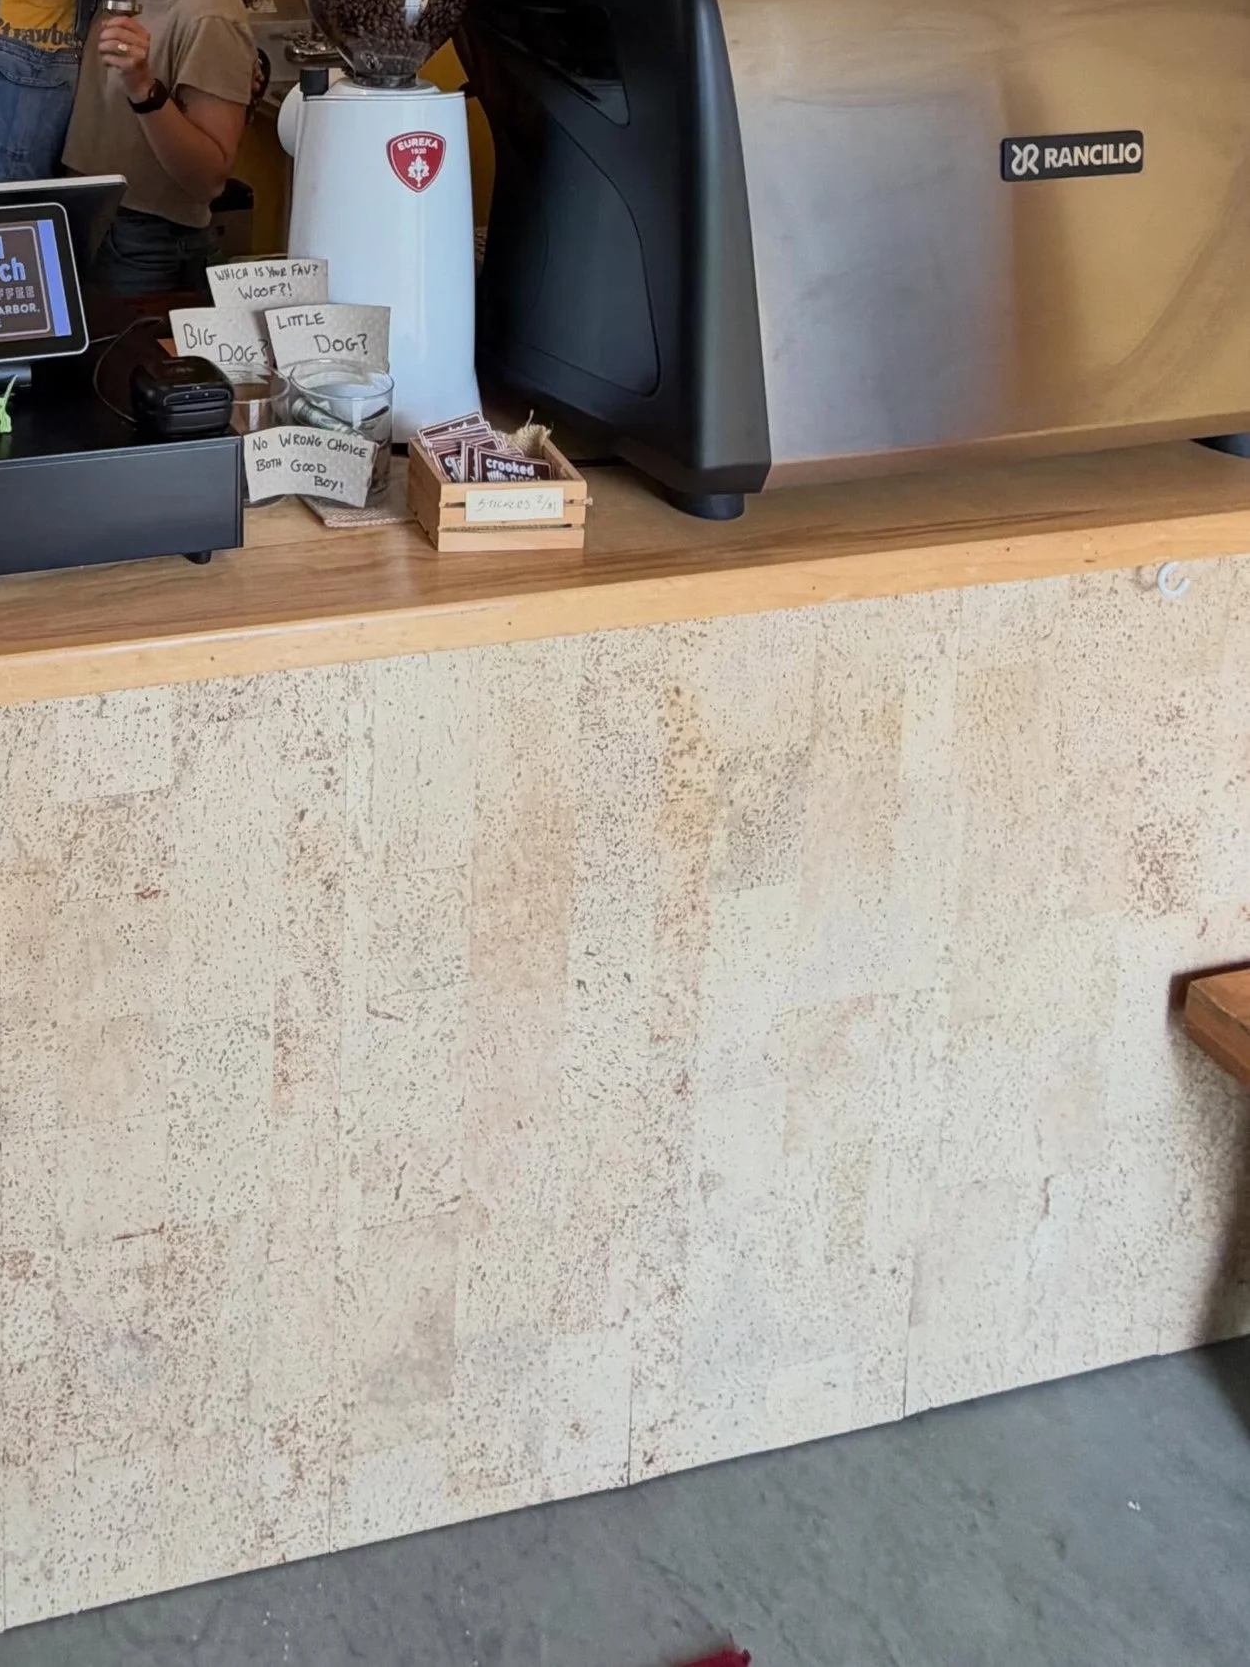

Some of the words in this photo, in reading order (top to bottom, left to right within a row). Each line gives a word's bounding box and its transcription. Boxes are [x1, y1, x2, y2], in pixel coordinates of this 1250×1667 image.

[396, 137, 438, 151] EUREKA
[1044, 142, 1142, 169] RANCILIO
[214, 267, 248, 281] WHICH
[254, 266, 265, 278] IS
[290, 263, 319, 276] FAV?
[238, 282, 293, 300] WOOF?!
[276, 312, 326, 329] LITTLE
[183, 323, 217, 349] BIG
[314, 333, 368, 355] DOG?
[218, 338, 269, 364] DOG?
[279, 433, 322, 448] WRONG
[327, 438, 368, 458] CHOICE
[256, 458, 282, 471] BOTH
[290, 459, 327, 474] GOOD
[485, 458, 535, 476] crooked
[314, 475, 344, 493] BOY!
